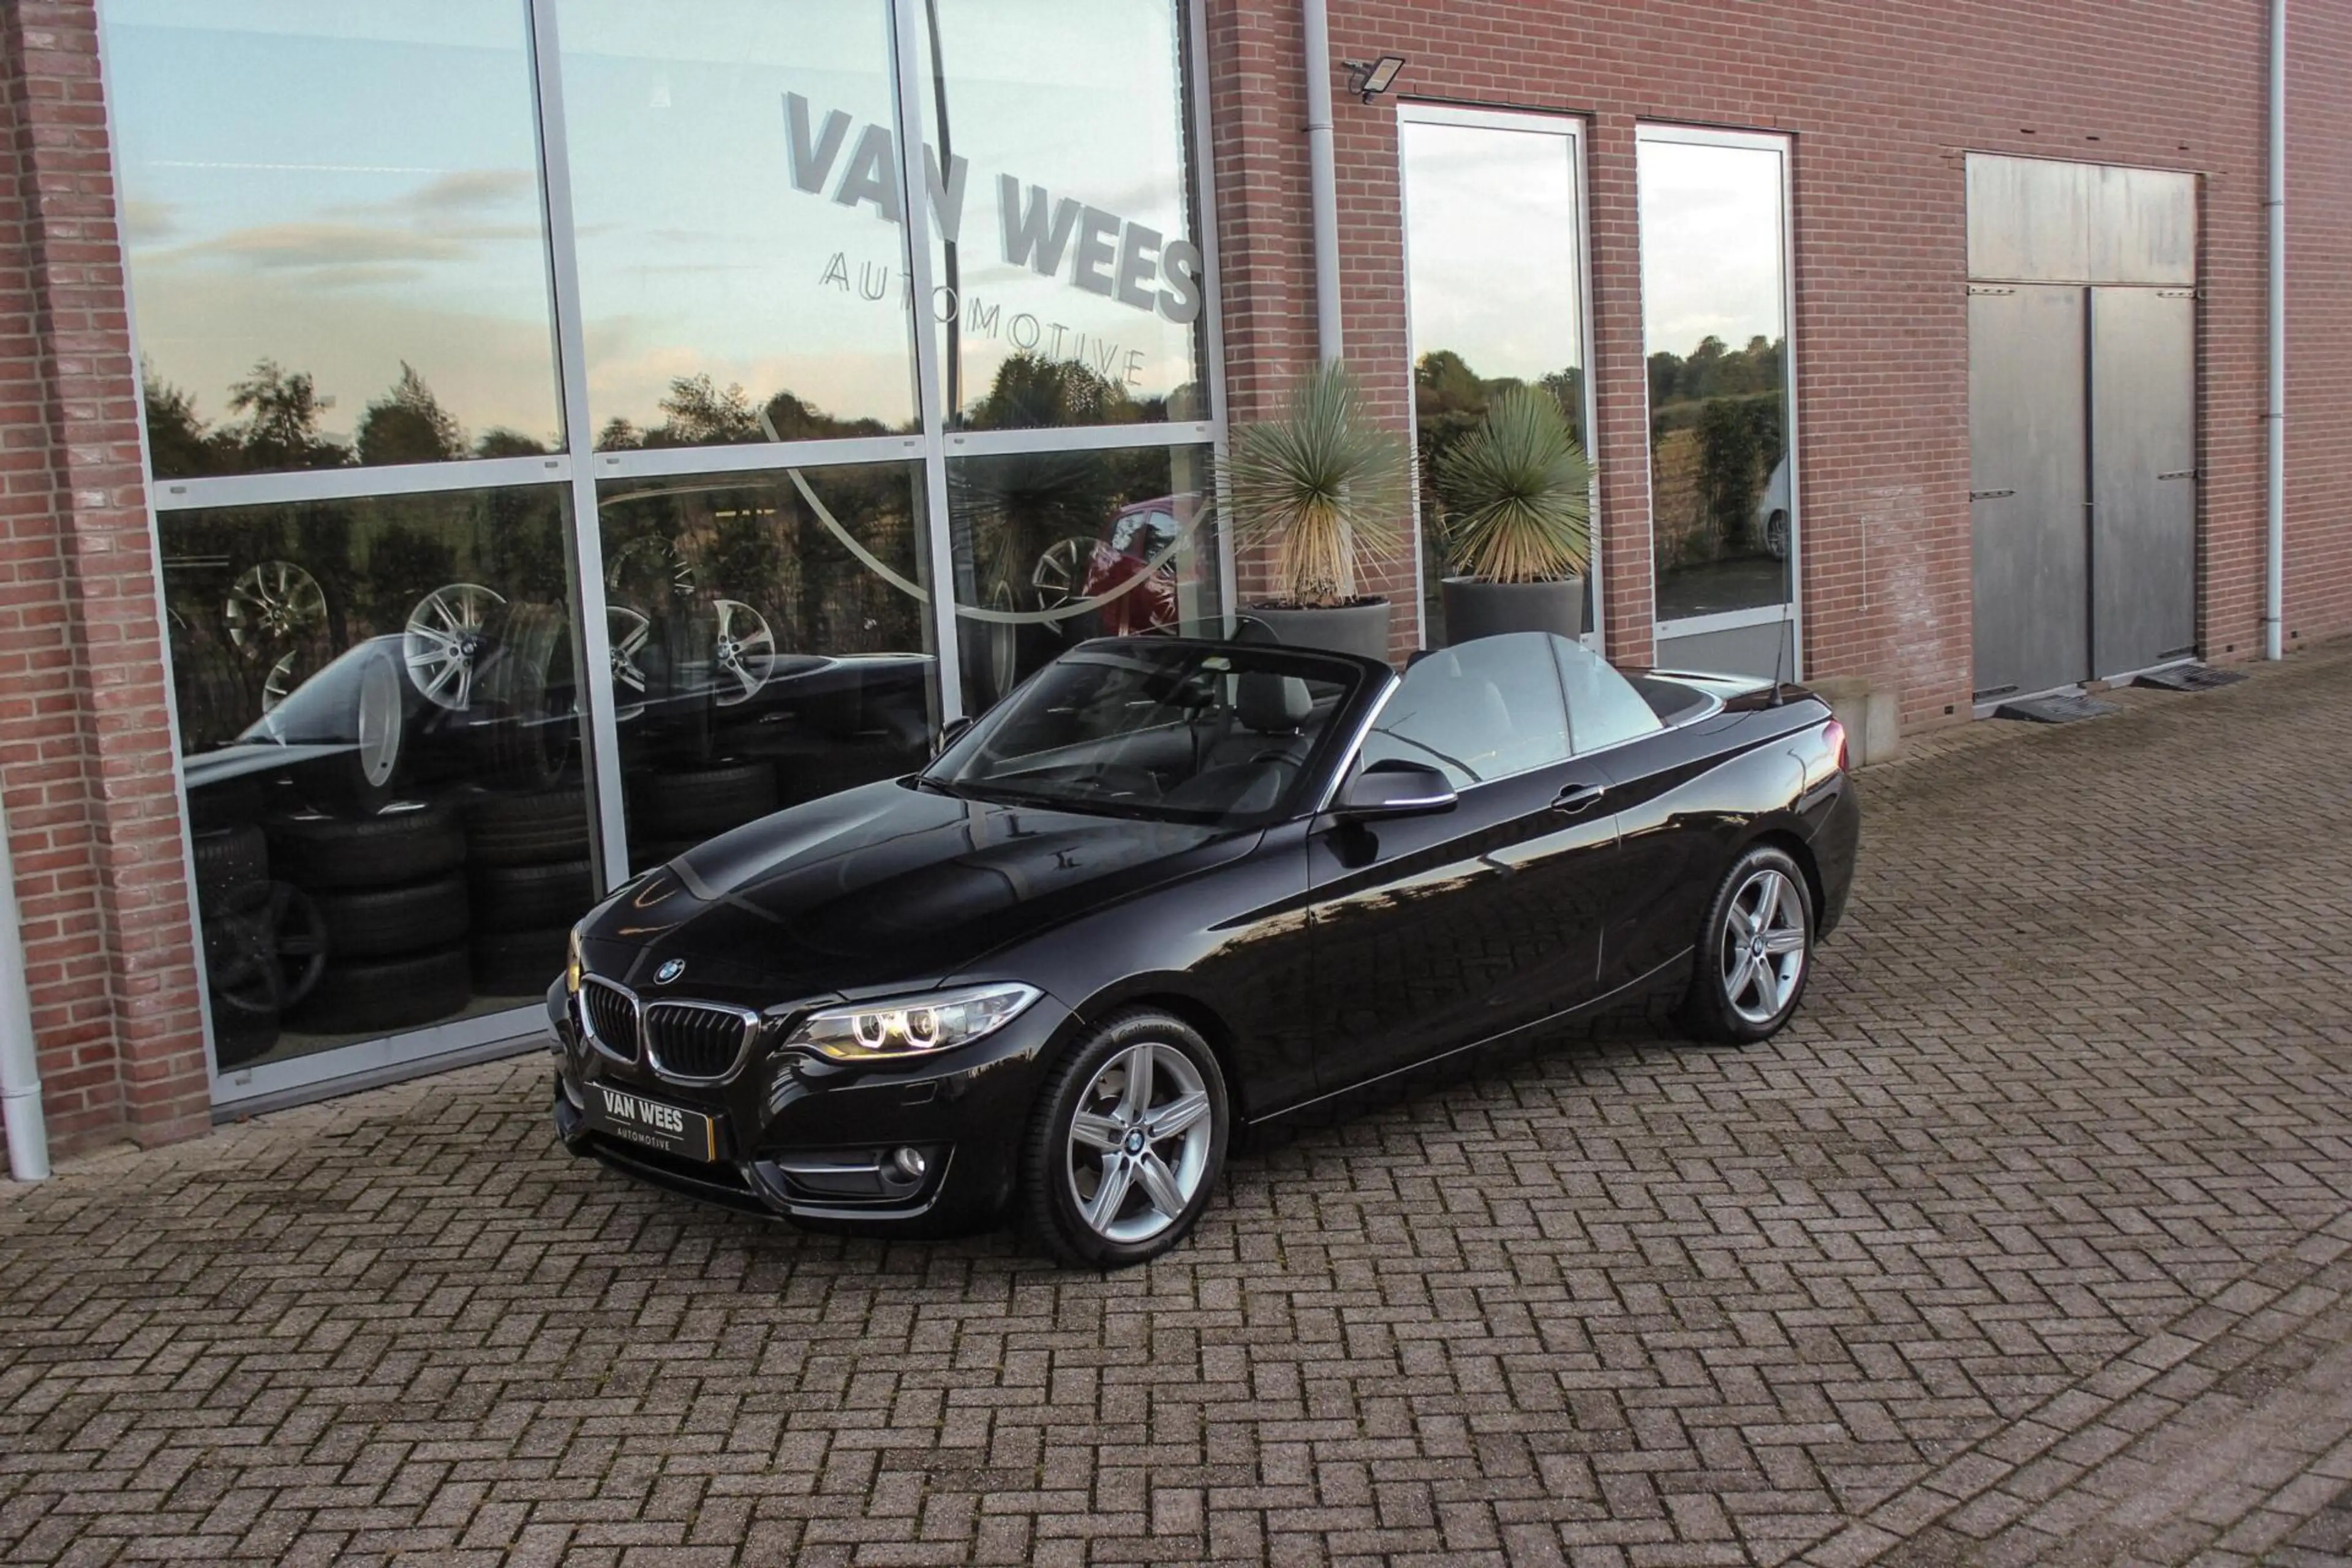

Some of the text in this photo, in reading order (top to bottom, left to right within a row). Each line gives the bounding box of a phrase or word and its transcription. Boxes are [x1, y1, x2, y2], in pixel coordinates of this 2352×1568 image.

[997, 172, 1202, 324] WEES
[603, 1090, 684, 1133] VAN WEES
[617, 1127, 671, 1151] AUTOMOTIVE
